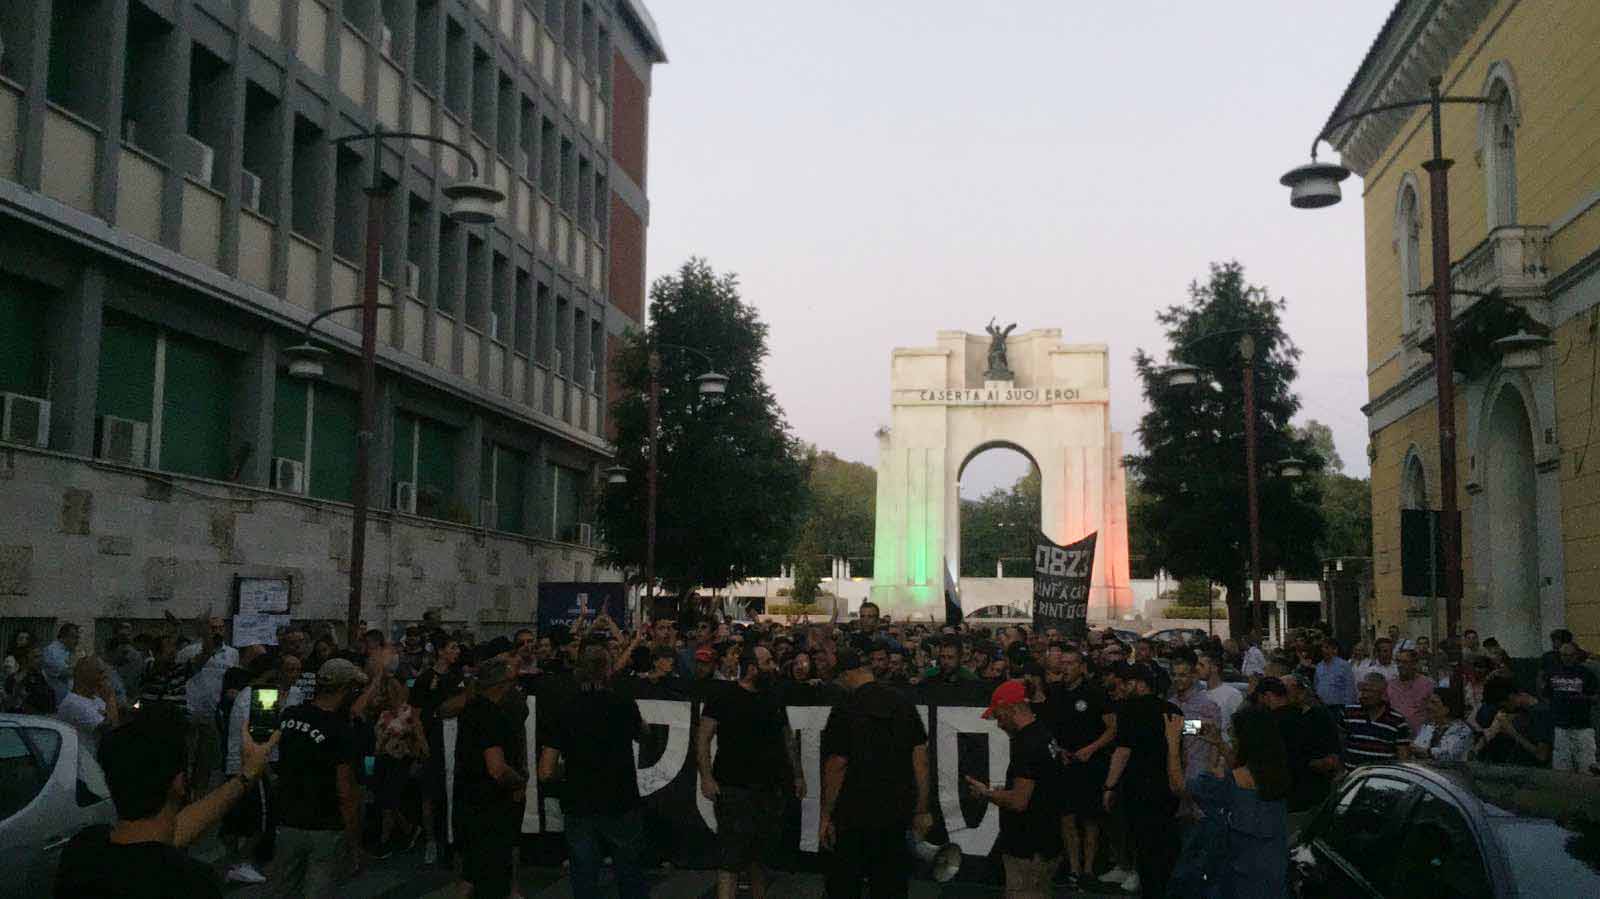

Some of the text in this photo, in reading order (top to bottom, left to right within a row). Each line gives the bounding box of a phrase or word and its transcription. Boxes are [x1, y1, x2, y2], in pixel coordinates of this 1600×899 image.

[920, 388, 1080, 401] CASERTA AI SUOI EROI
